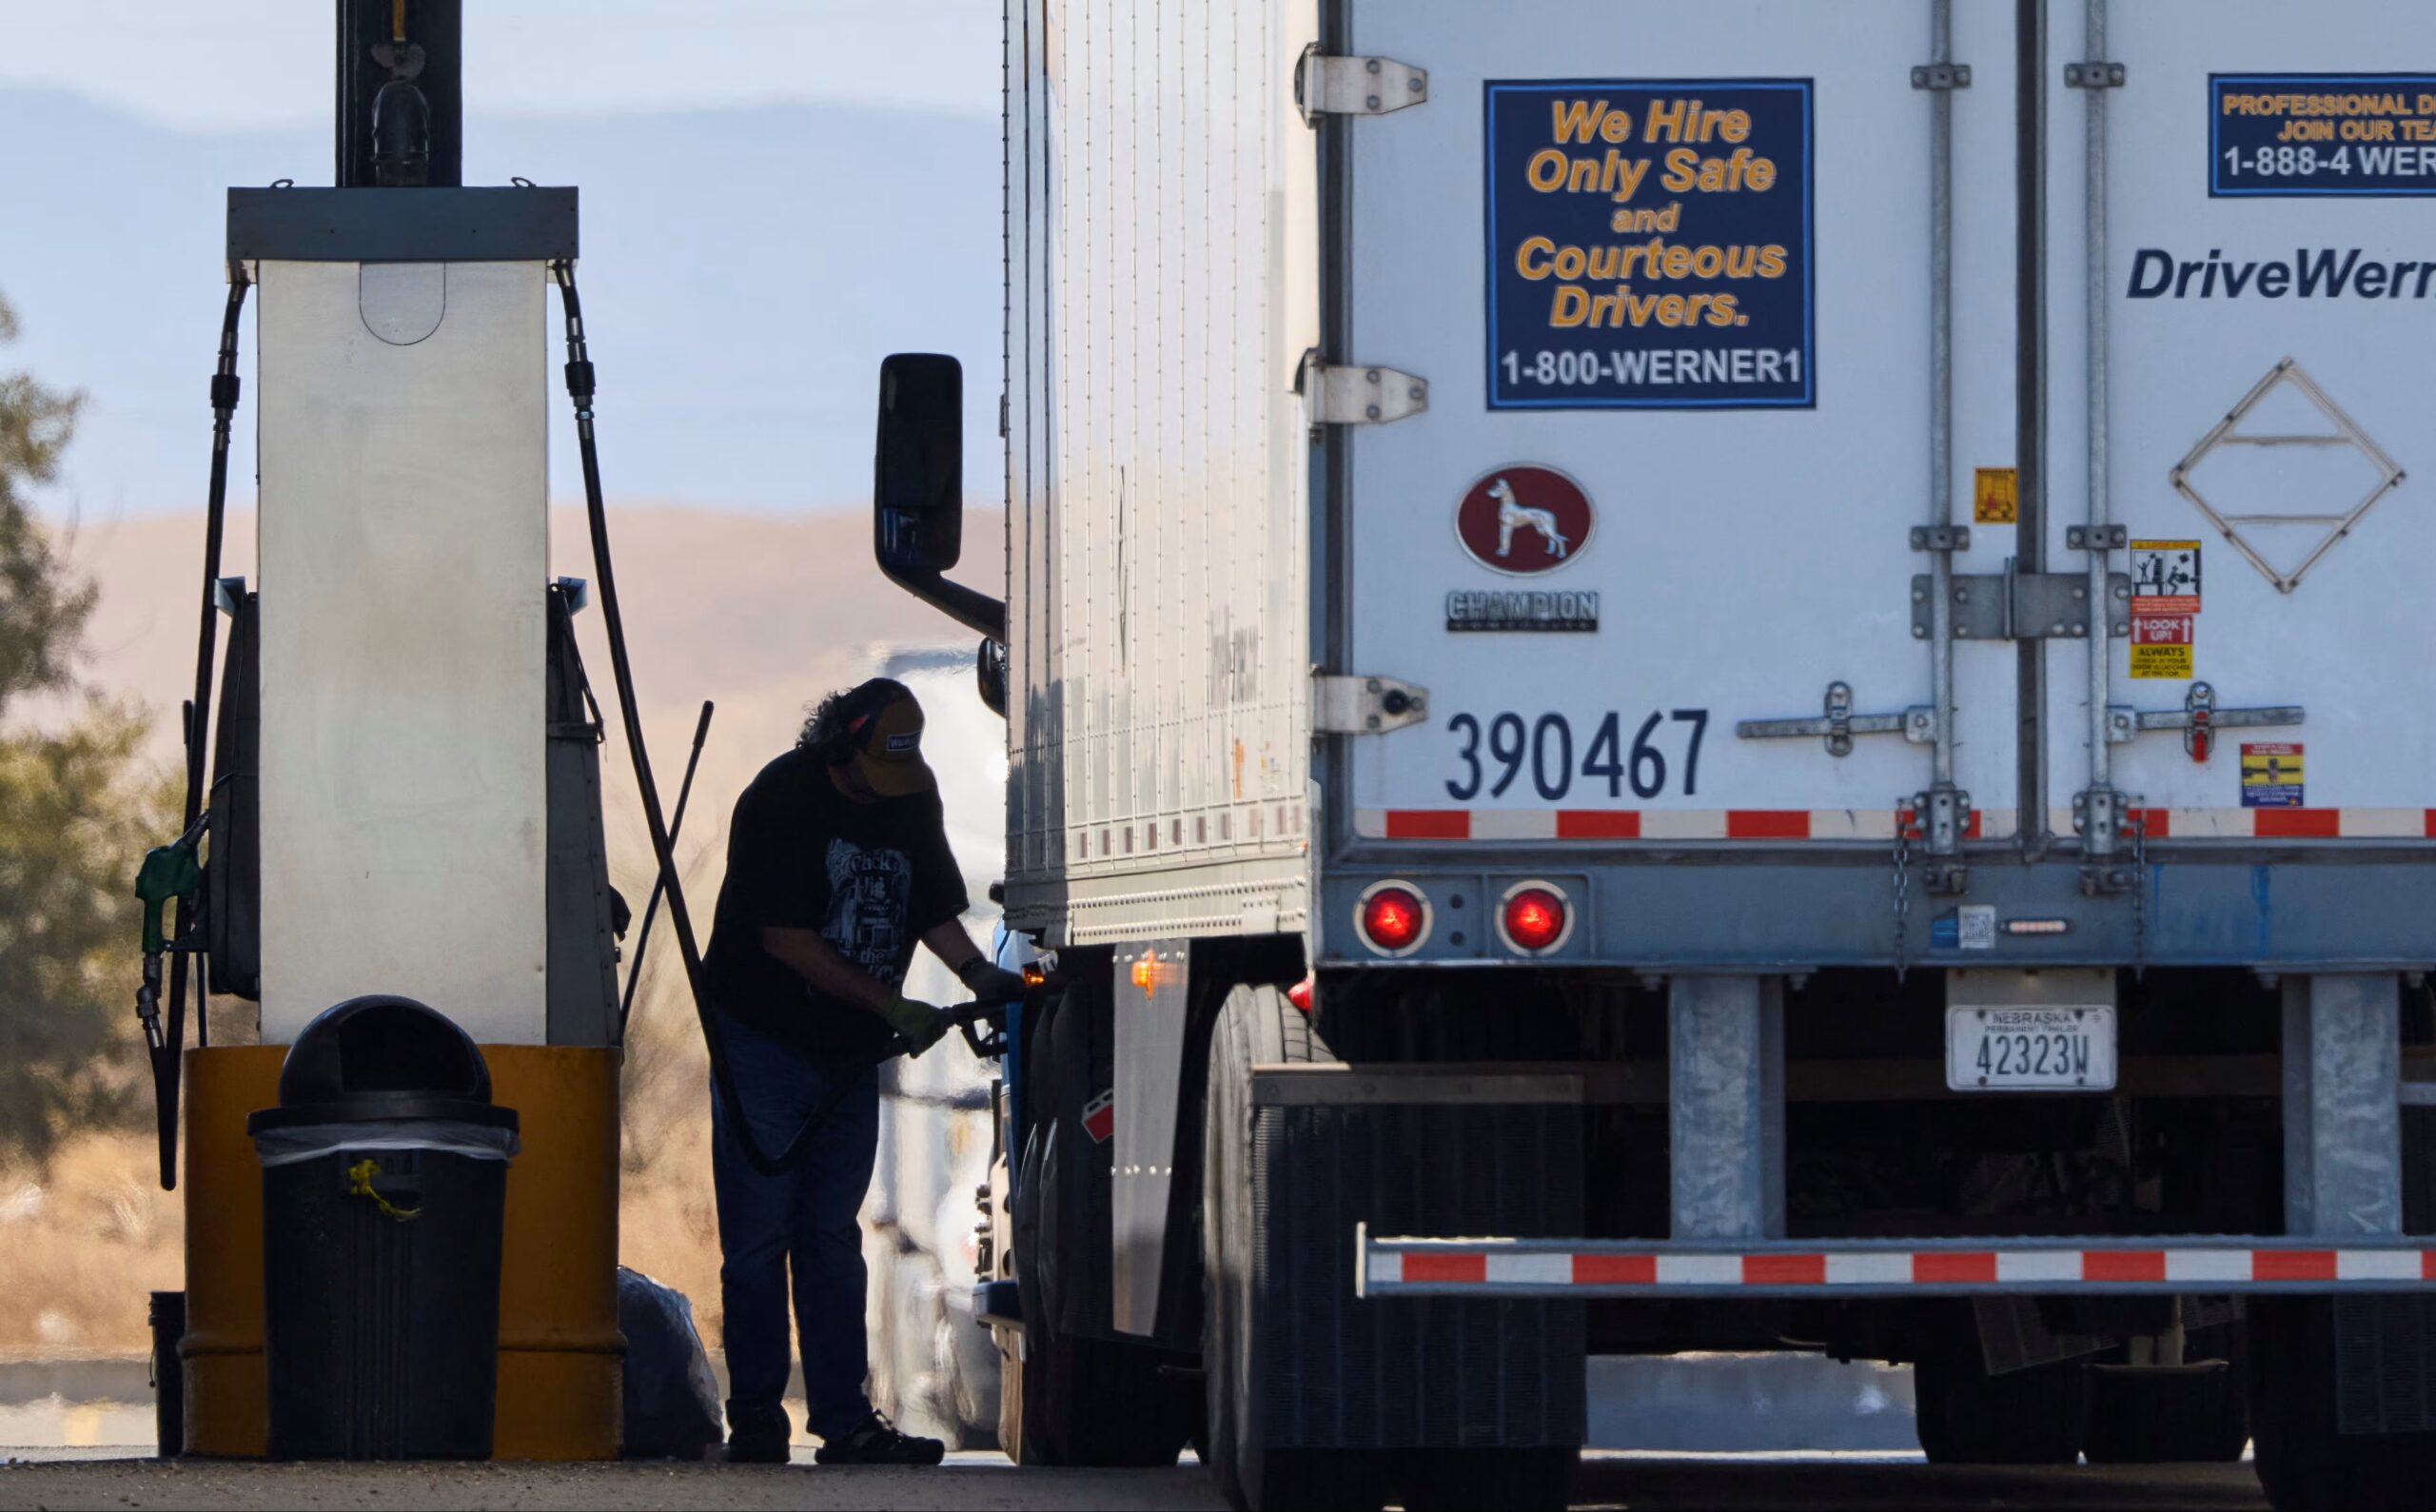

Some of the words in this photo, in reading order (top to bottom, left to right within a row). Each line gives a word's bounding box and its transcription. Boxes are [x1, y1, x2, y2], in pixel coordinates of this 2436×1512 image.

[2222, 93, 2413, 115] PROFESSIONAL
[2417, 93, 2436, 115] D
[1551, 100, 1632, 143] We
[1643, 100, 1752, 143] Hire
[2277, 120, 2335, 141] JOIN
[2339, 120, 2395, 141] OUR
[1526, 147, 1650, 202] Only
[1660, 147, 1777, 192] Safe
[2224, 146, 2351, 176] 1-888-4
[2356, 146, 2436, 176] WER
[1610, 202, 1681, 233] and
[1515, 236, 1788, 280] Courteous
[1549, 285, 1749, 327] Drivers.
[1501, 348, 1800, 385] 1-800-WERNER1
[1445, 591, 1599, 620] CHAMPION
[2143, 619, 2180, 631] LOOK
[2139, 647, 2186, 657] ALWAYS
[1444, 709, 1708, 800] 390467
[1992, 1011, 2072, 1025] NEBRASKA
[1976, 1034, 2089, 1075] 42323W
